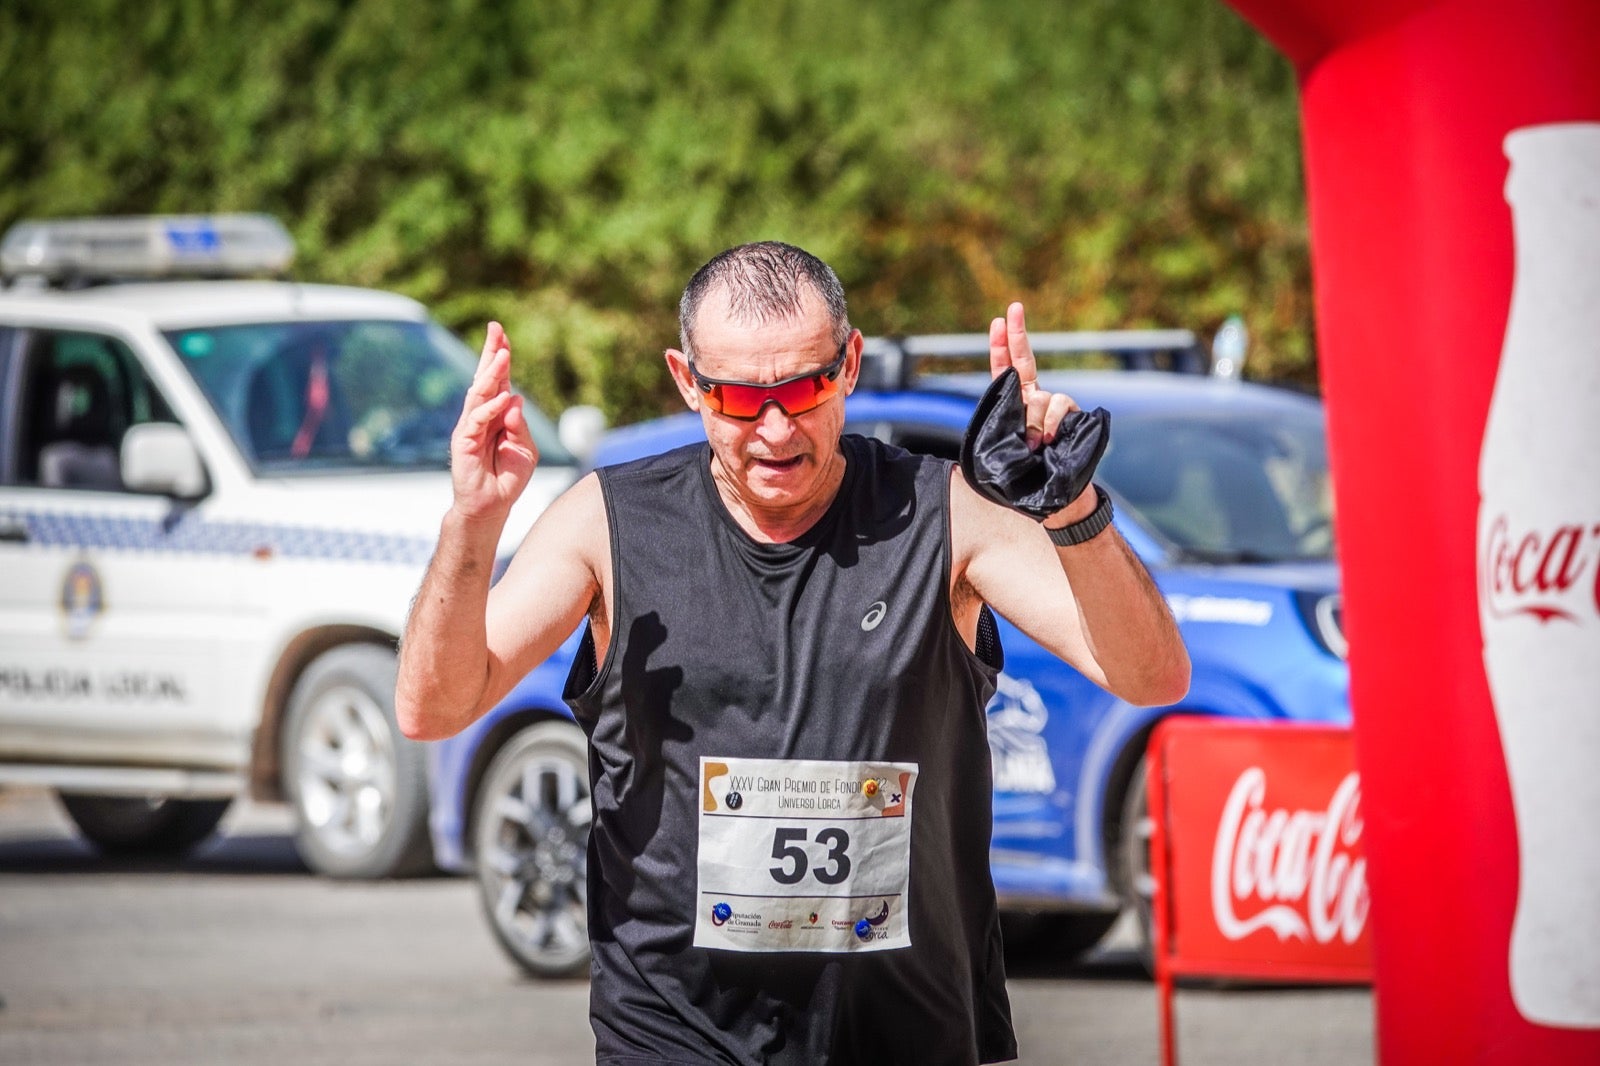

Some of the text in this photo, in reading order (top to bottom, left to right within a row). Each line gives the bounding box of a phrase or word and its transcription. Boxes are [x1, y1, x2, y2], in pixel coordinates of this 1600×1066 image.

[729, 775, 754, 791] XXXV
[769, 827, 851, 885] 53
[730, 912, 761, 920] iputación
[865, 931, 888, 940] orca
